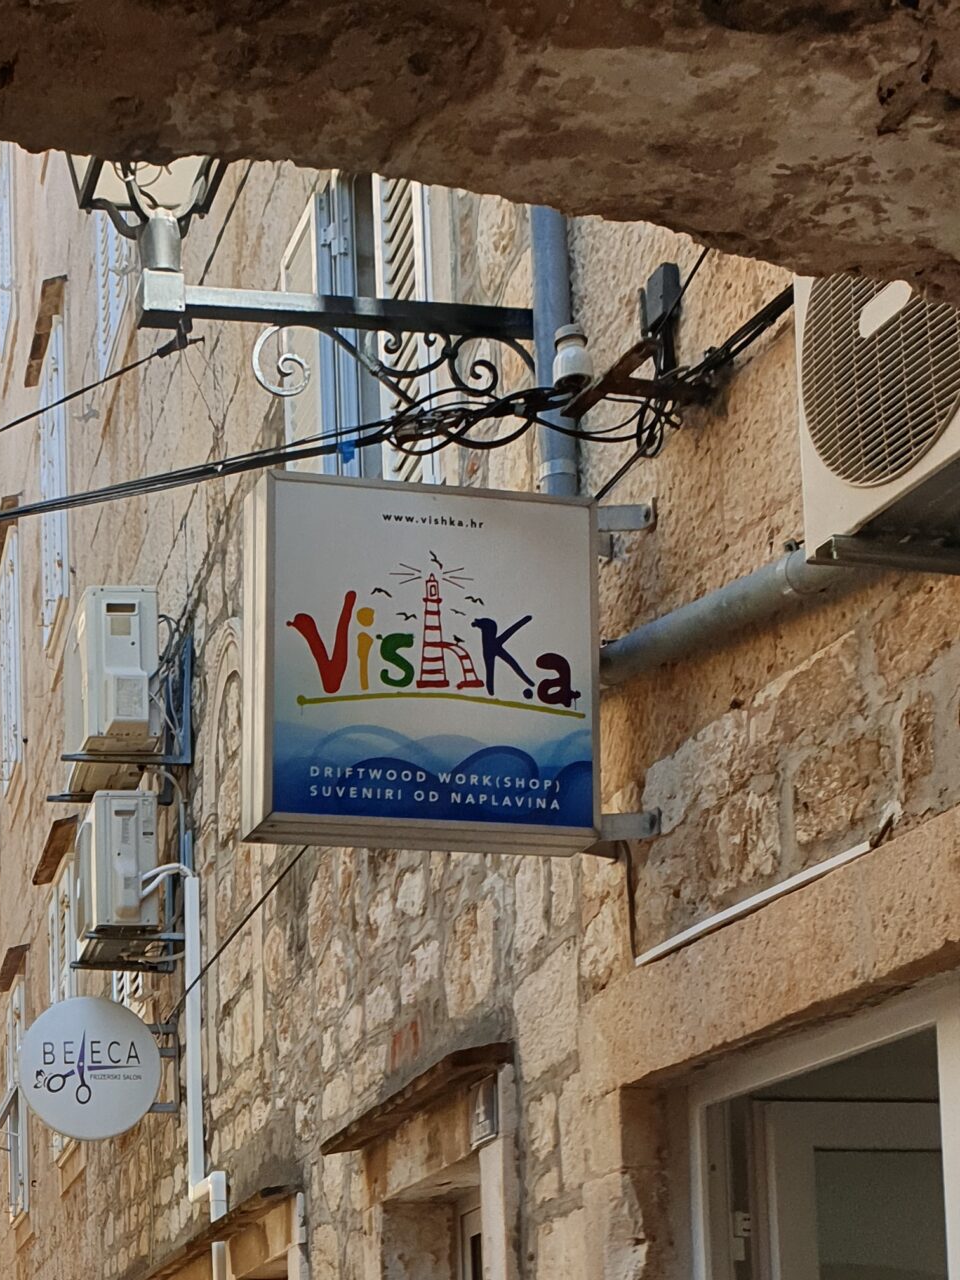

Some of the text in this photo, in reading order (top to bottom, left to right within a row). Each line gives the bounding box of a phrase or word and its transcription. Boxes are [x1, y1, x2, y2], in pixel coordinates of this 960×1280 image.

[382, 513, 484, 529] www.vishka.hr
[309, 765, 561, 793] DRIFTWOOD WORK(SHOP)
[309, 784, 561, 811] SUVENIRI OD NAPLAVINA
